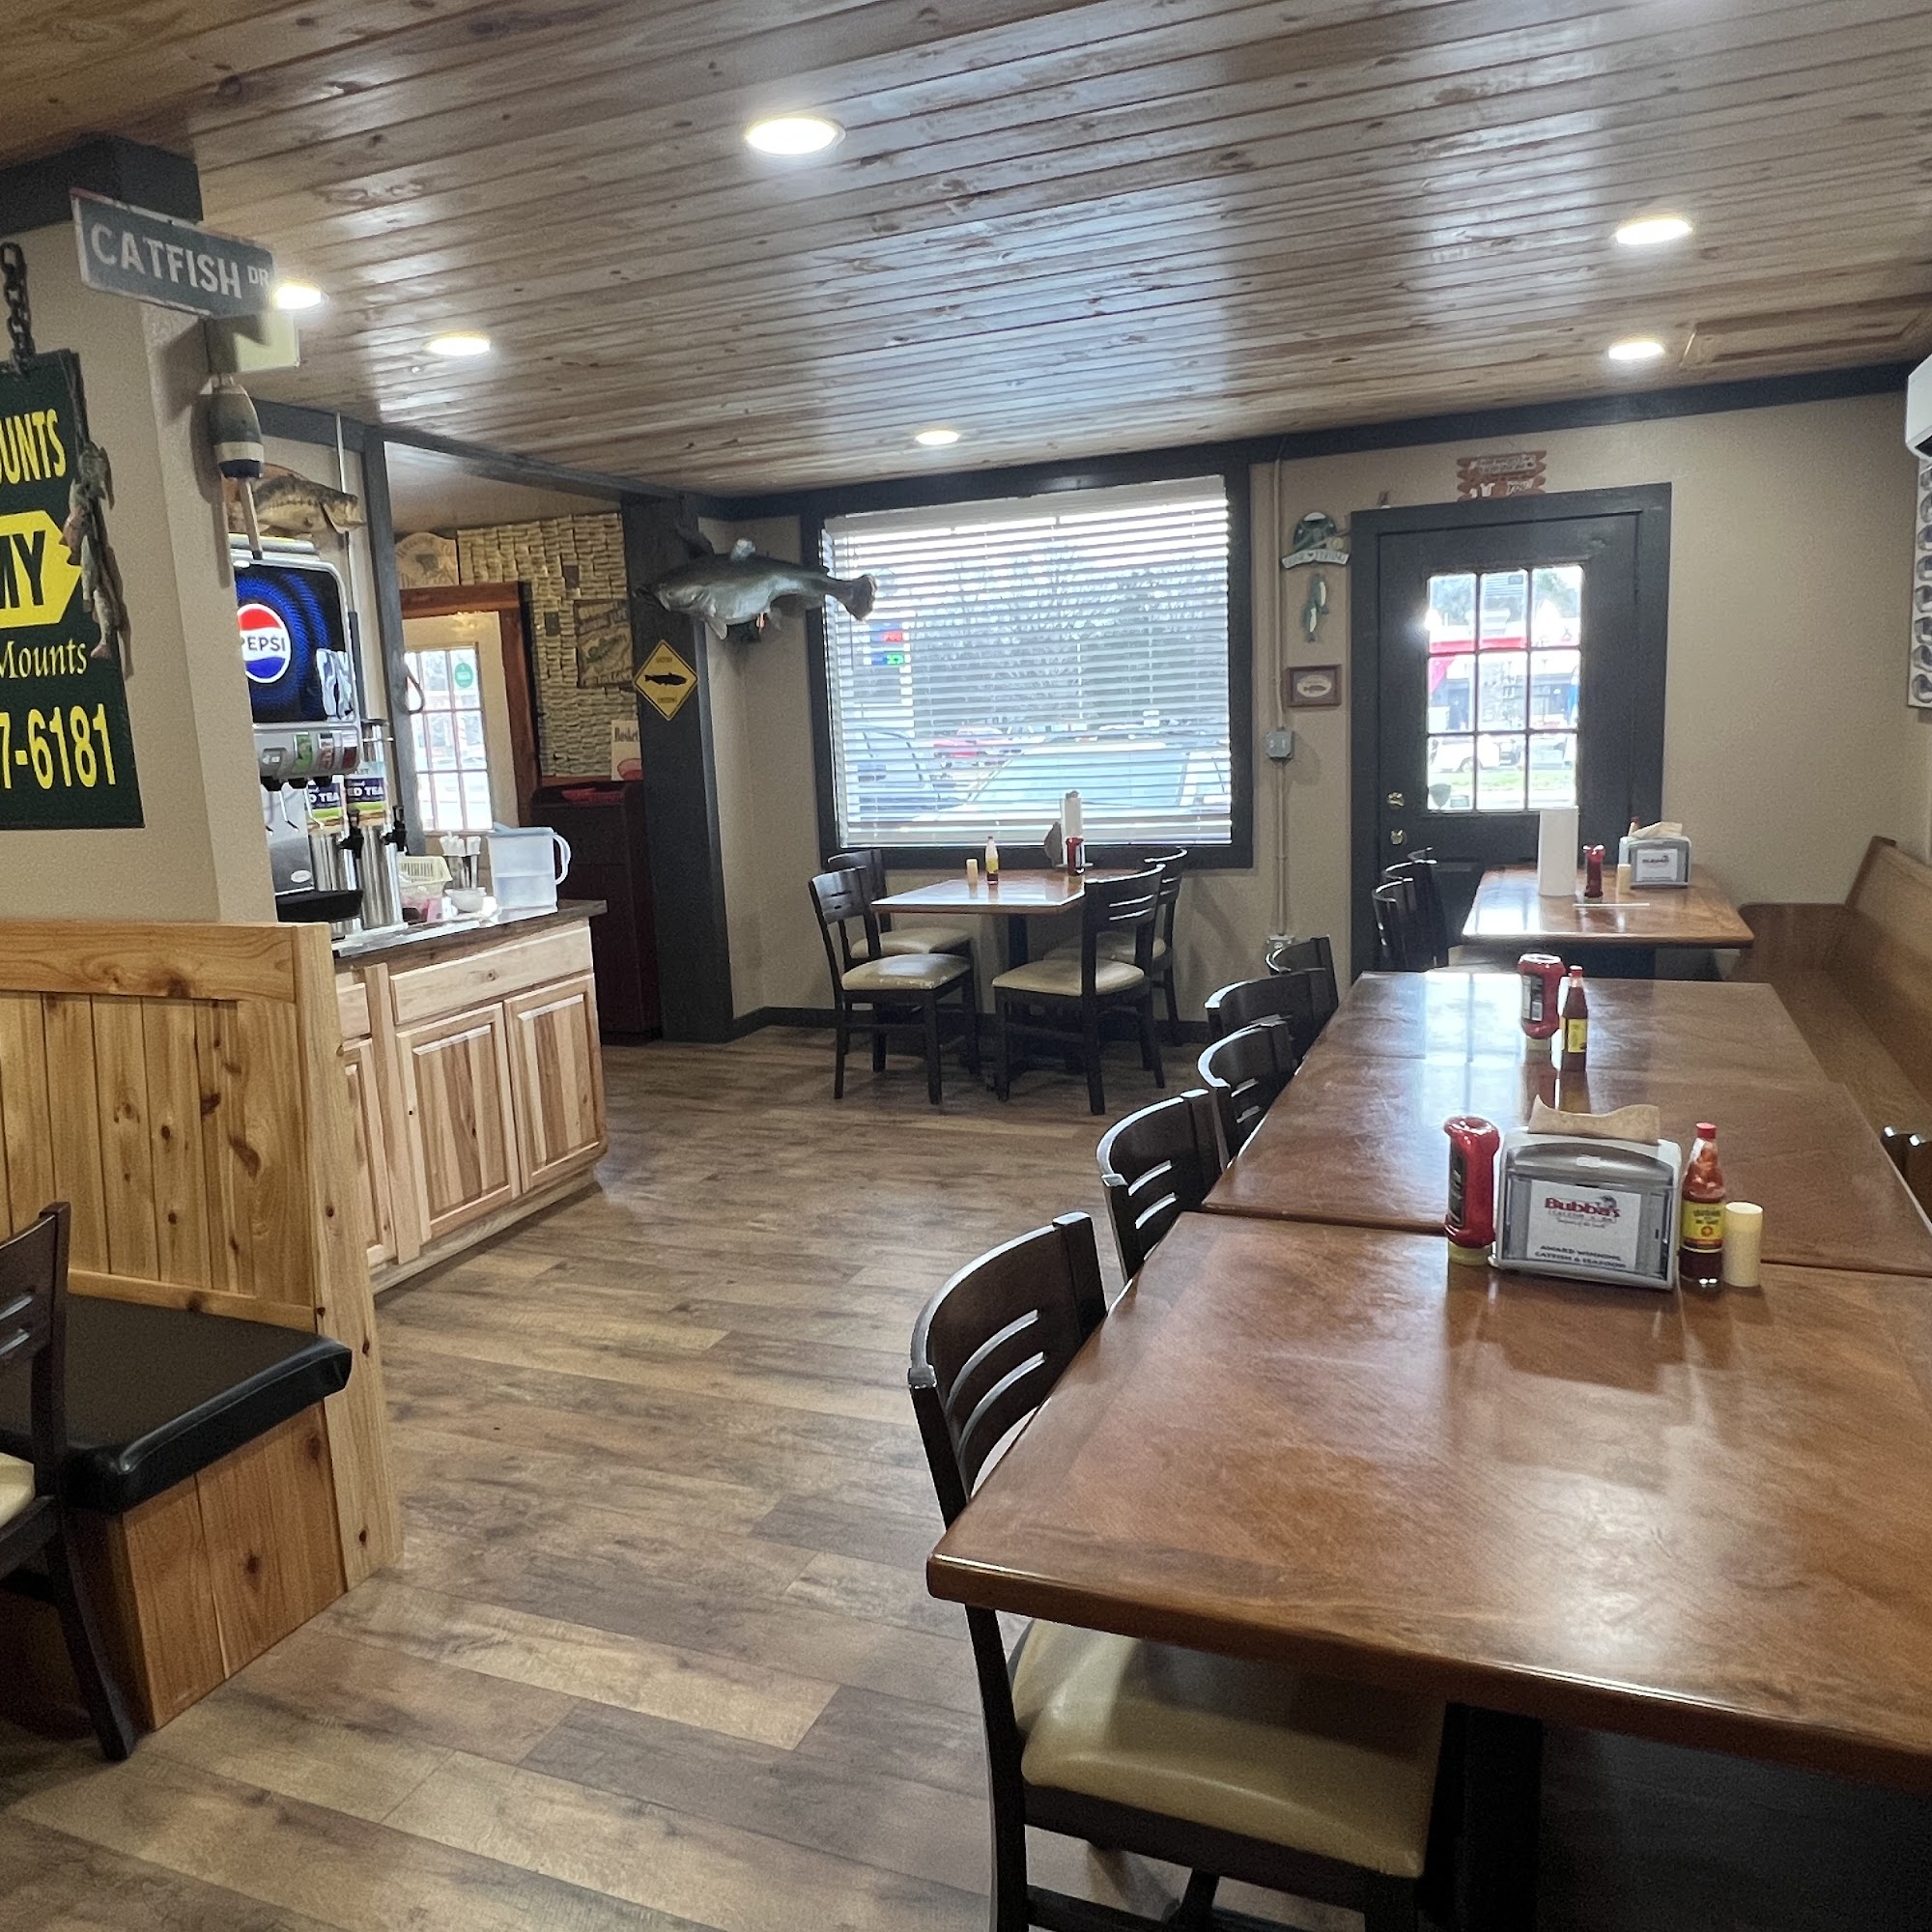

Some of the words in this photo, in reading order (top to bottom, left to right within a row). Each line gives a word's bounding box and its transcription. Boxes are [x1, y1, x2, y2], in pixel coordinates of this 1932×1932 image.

[91, 223, 242, 299] CATFISH
[247, 266, 270, 286] DR
[0, 409, 66, 484] UNTS
[319, 792, 340, 803] TEA
[364, 786, 384, 796] TEA
